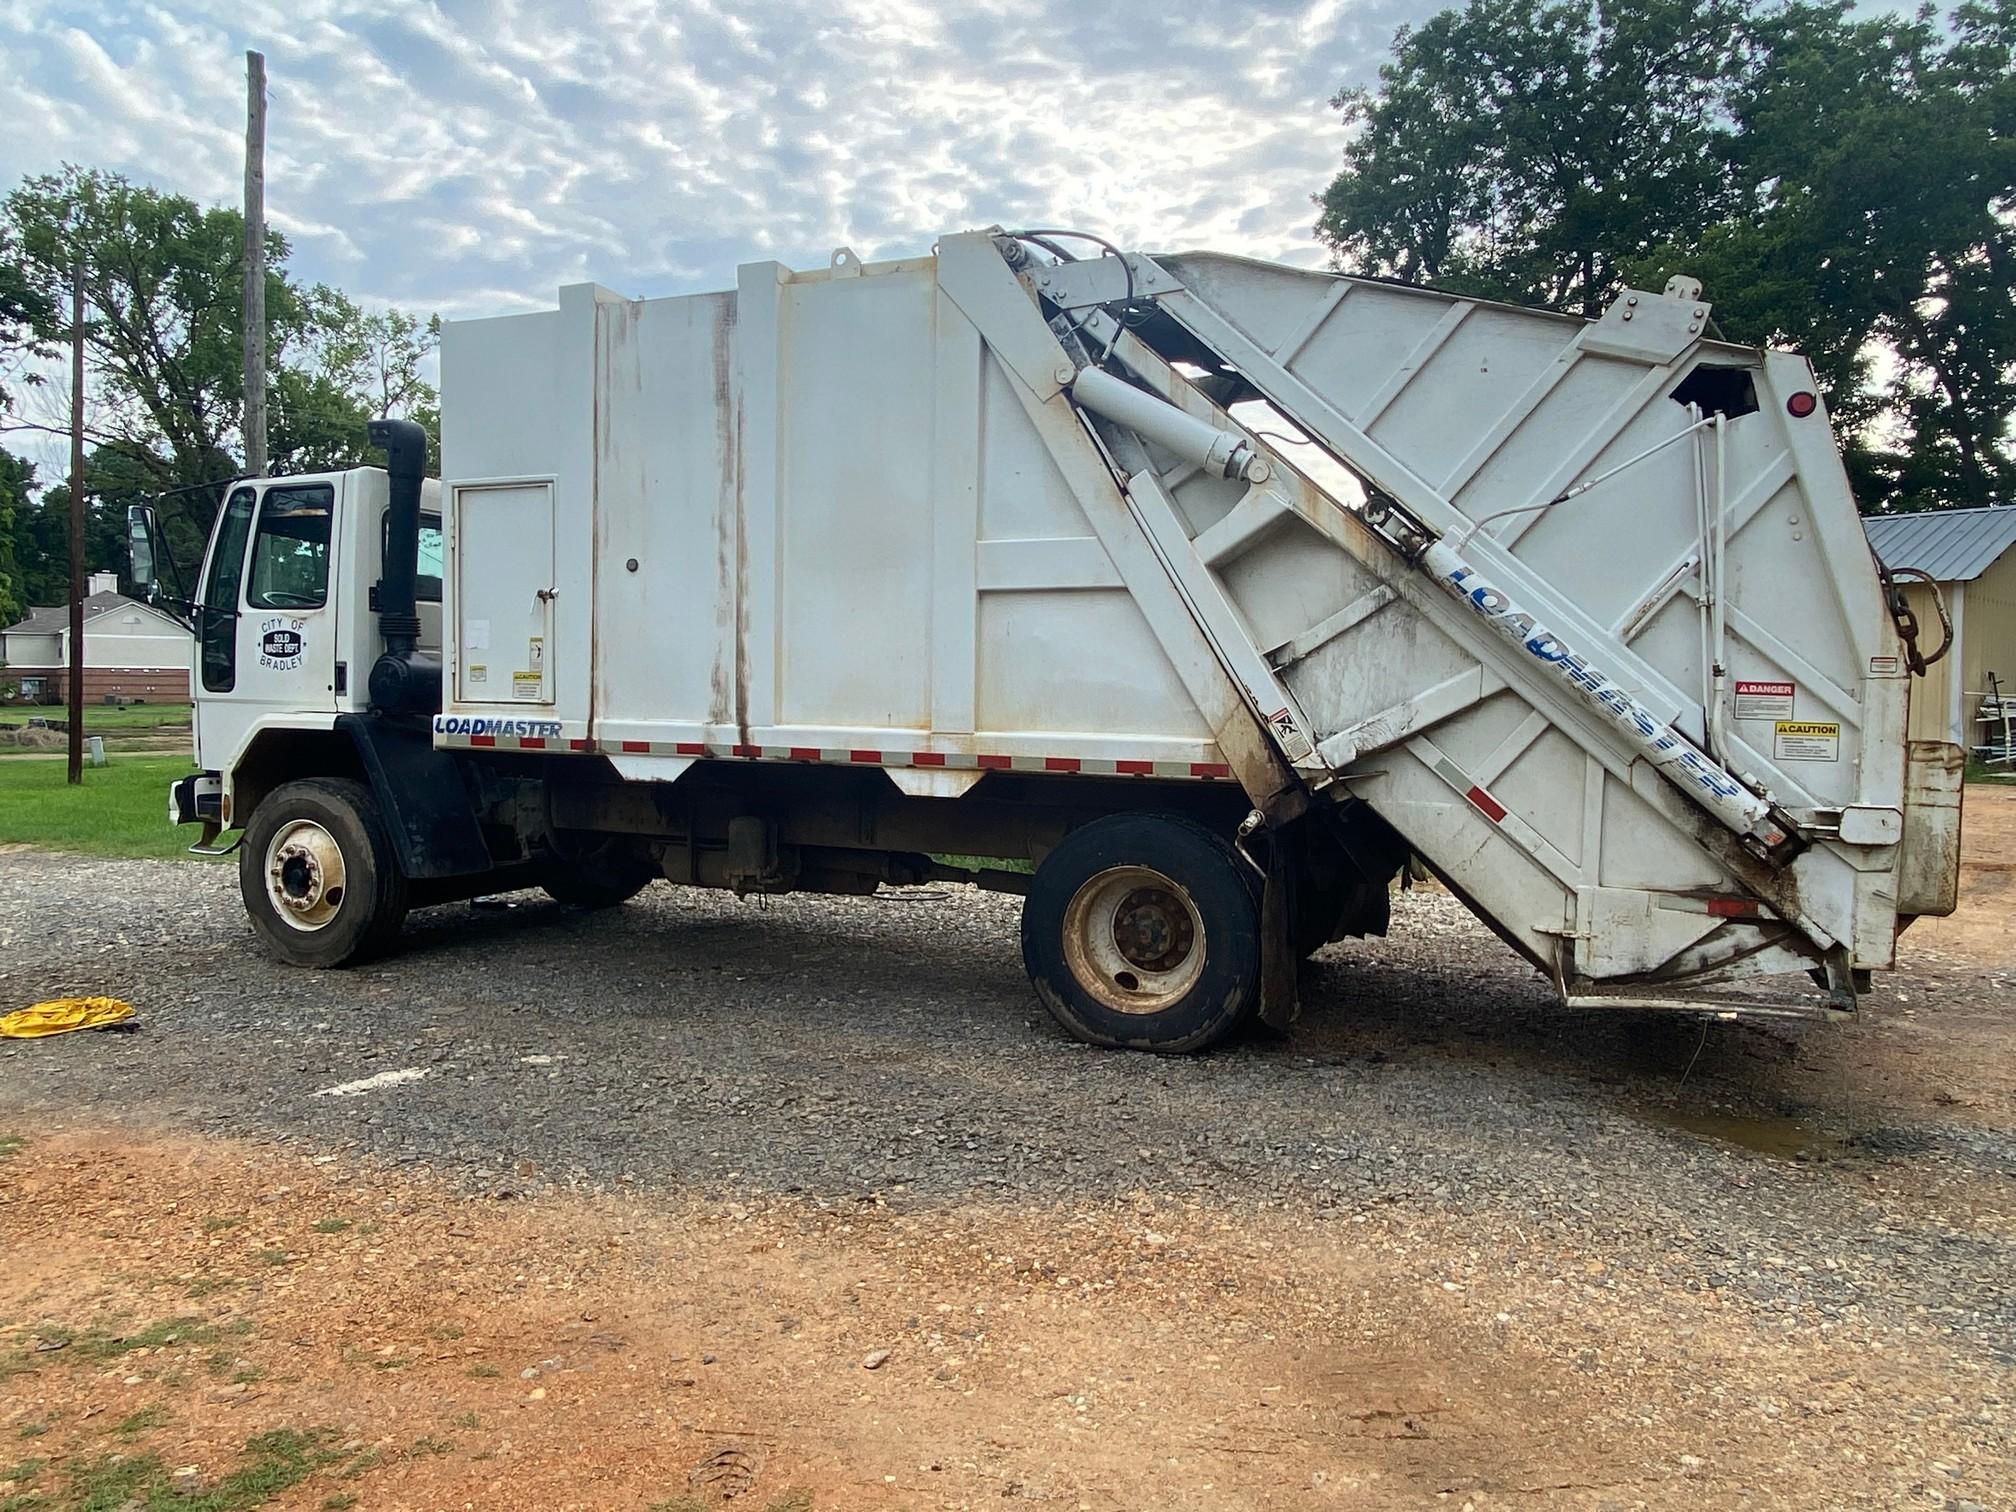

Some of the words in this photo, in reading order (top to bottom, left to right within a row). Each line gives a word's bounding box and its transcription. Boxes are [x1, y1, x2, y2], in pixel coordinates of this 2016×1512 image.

[261, 618, 283, 633] CITY
[291, 619, 305, 631] OF
[259, 655, 303, 671] BRADLEY
[1446, 565, 1741, 799] LOADMASTER
[1749, 684, 1792, 694] DANGER
[435, 717, 563, 739] LOADMASTER
[1788, 725, 1837, 734] CAUTION
